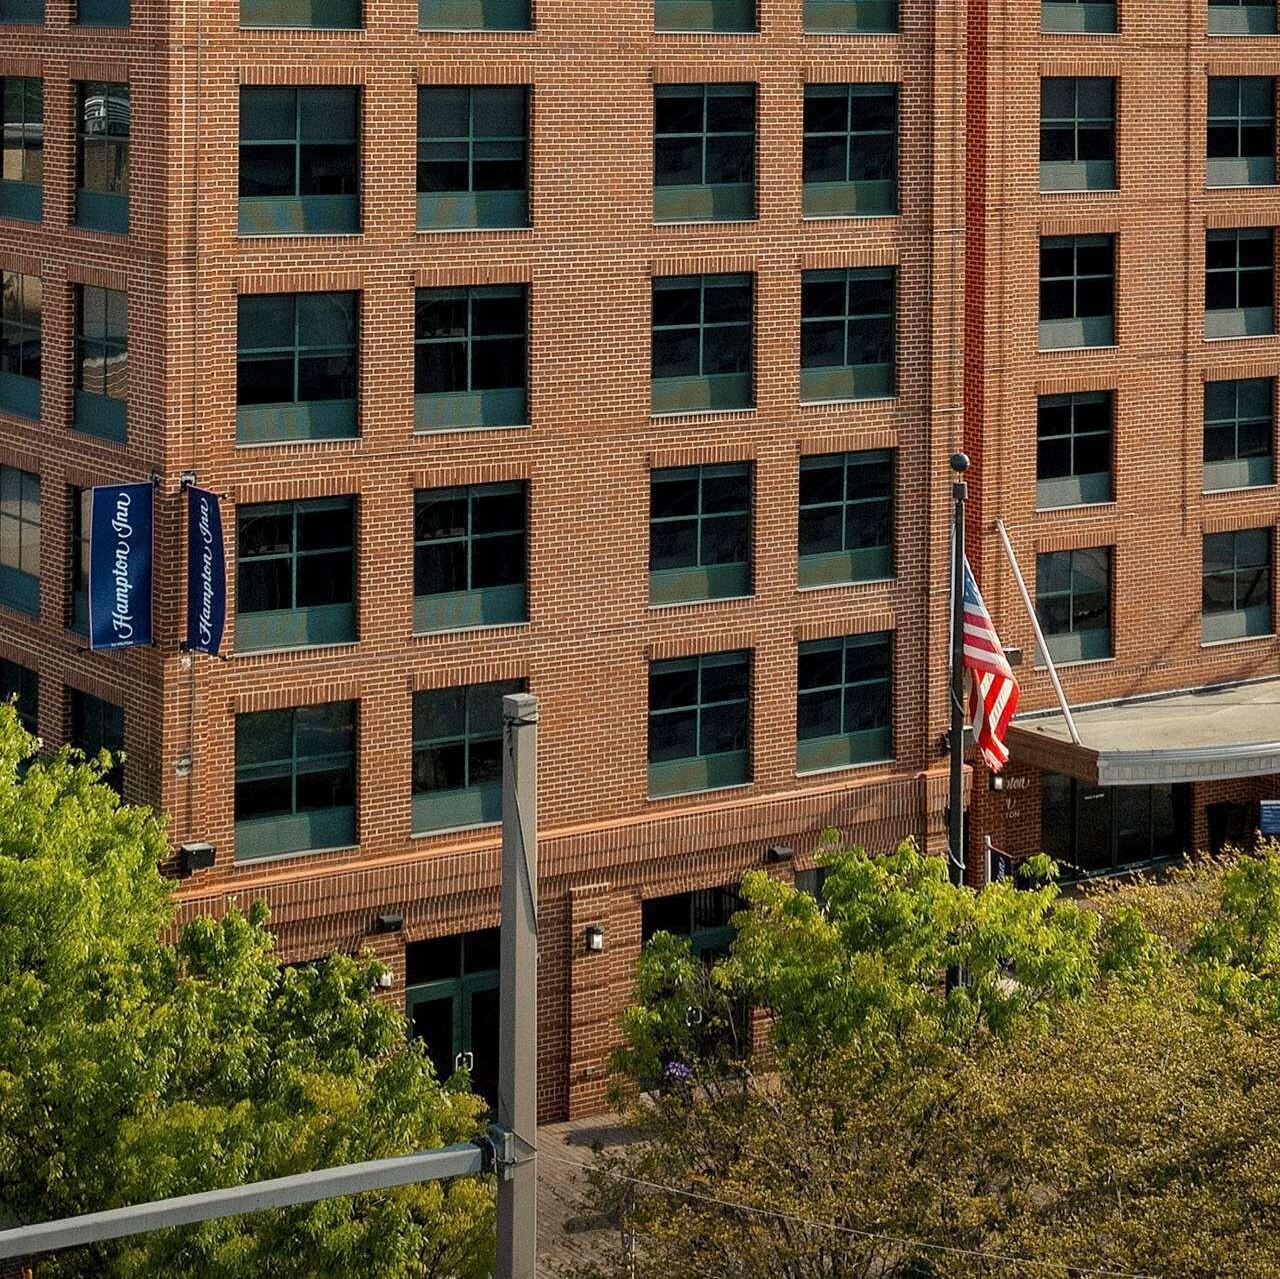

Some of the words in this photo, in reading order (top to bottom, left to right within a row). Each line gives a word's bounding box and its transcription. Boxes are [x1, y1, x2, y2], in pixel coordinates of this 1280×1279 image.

[111, 492, 133, 538] Inn
[198, 497, 213, 544] Inn
[112, 540, 134, 639] Hampton
[199, 546, 215, 645] Hampton
